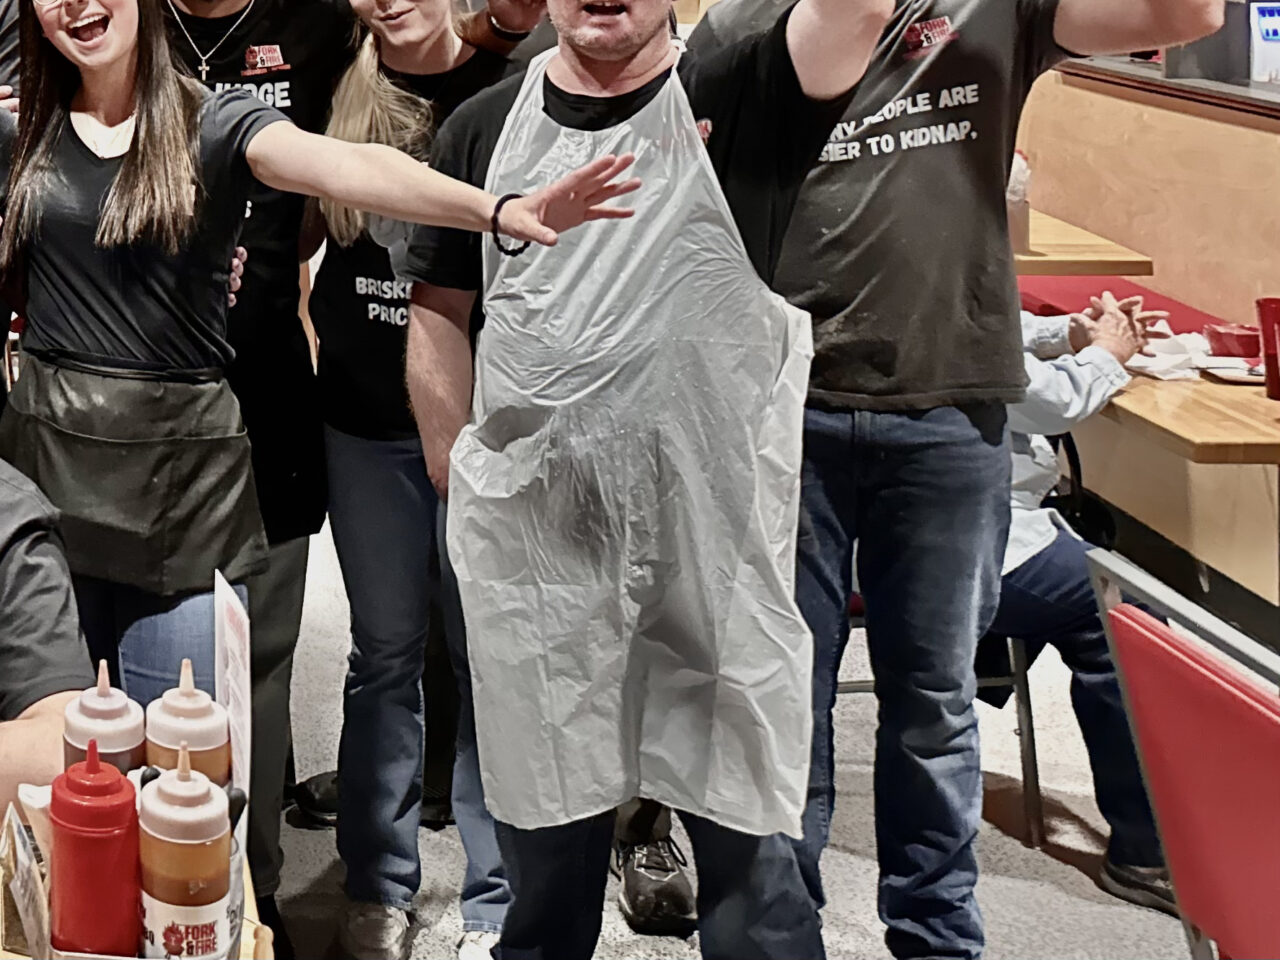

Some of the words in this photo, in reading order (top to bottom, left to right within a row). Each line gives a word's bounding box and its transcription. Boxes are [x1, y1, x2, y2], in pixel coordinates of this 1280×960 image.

[938, 84, 979, 109] ARE
[866, 134, 895, 156] TO
[184, 923, 216, 940] FORK
[195, 938, 217, 955] FIRE
